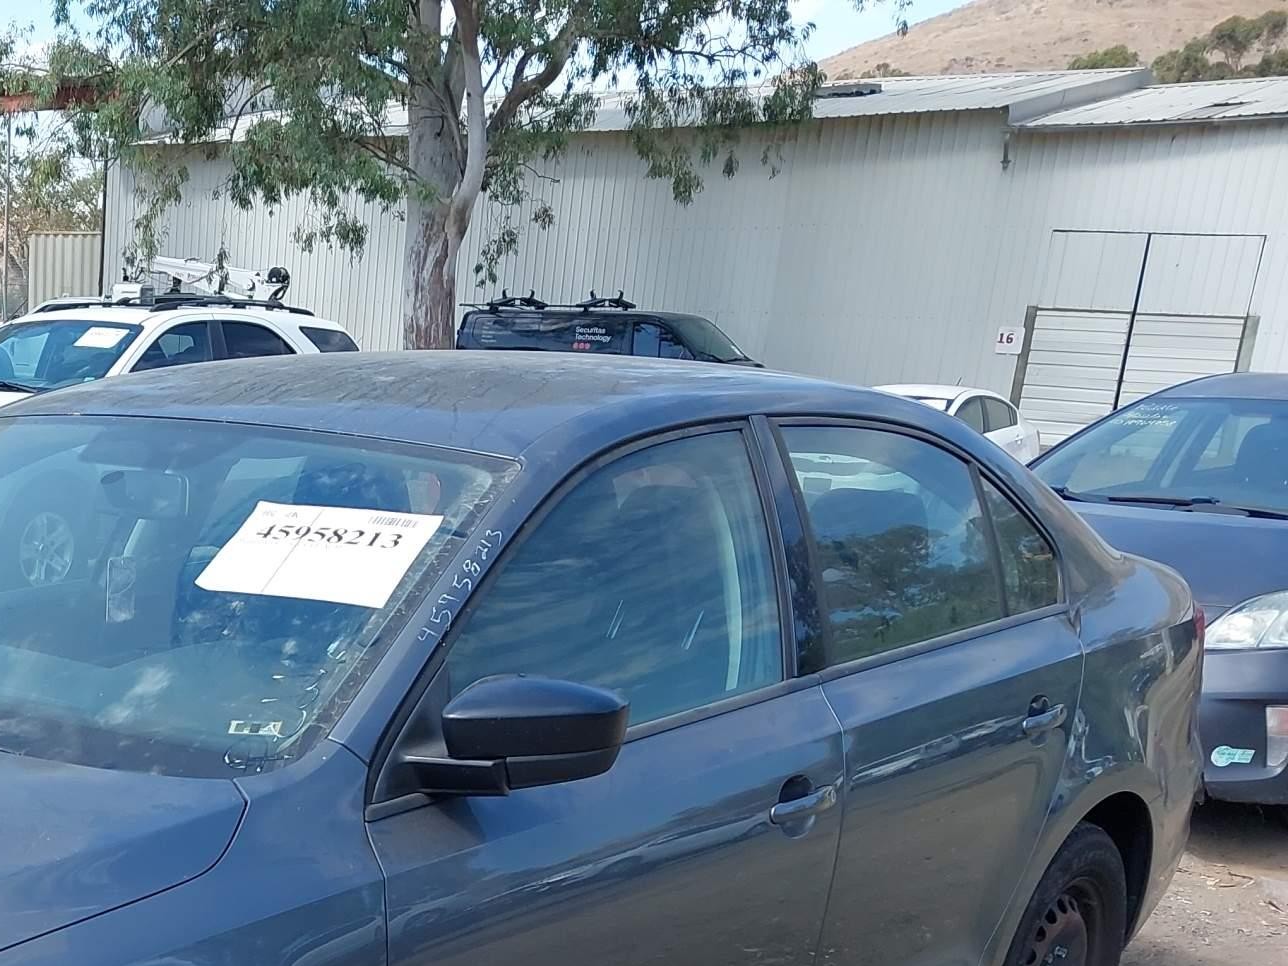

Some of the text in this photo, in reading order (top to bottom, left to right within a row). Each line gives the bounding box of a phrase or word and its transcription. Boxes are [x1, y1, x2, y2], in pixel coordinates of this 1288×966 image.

[575, 326, 606, 334] Securitas
[575, 333, 612, 343] Technology
[998, 332, 1014, 344] 16
[256, 524, 404, 549] 45958213
[418, 529, 503, 641] 45958213
